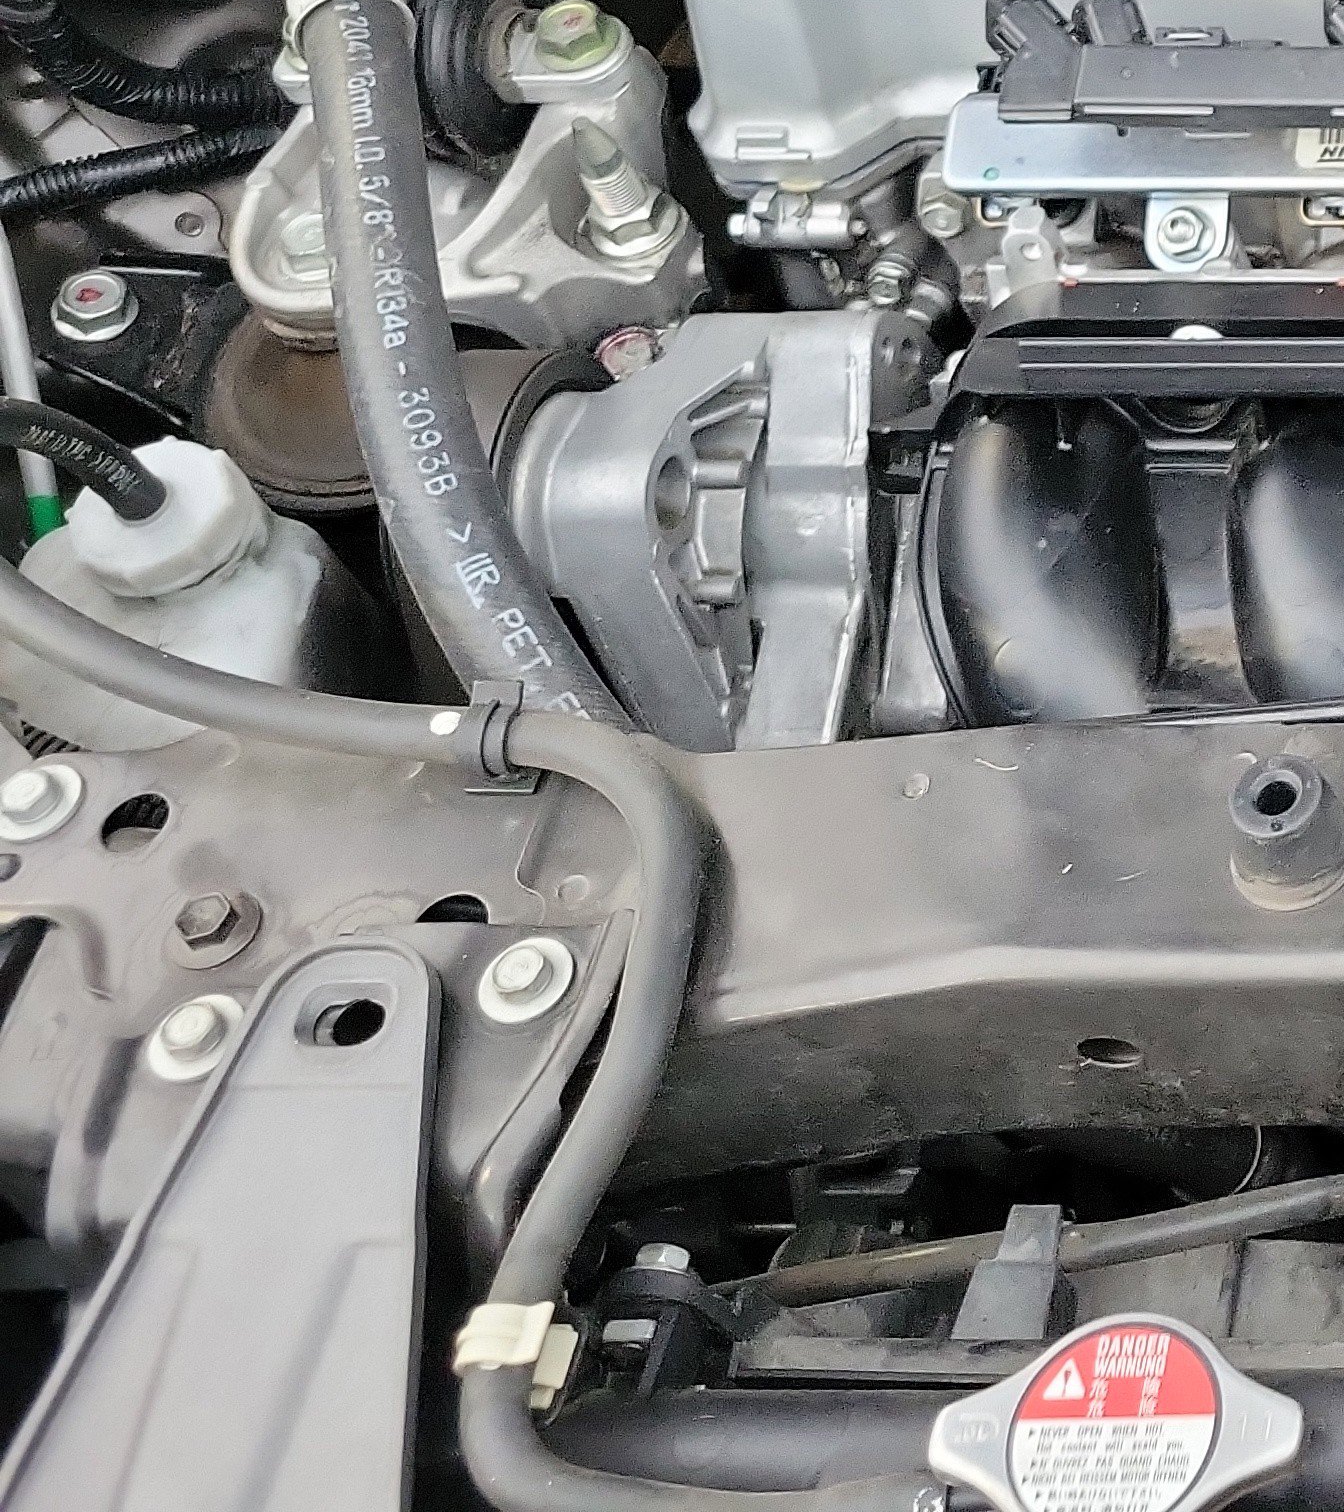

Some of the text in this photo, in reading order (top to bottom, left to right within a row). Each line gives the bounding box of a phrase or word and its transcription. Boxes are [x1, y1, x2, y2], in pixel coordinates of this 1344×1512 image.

[373, 267, 410, 350] R134a
[398, 387, 459, 497] 3093B
[1097, 1333, 1171, 1355] DANGER
[1094, 1354, 1168, 1379] WARNUNG
[1040, 1425, 1070, 1438] NEVER
[1077, 1425, 1104, 1437] OPEN
